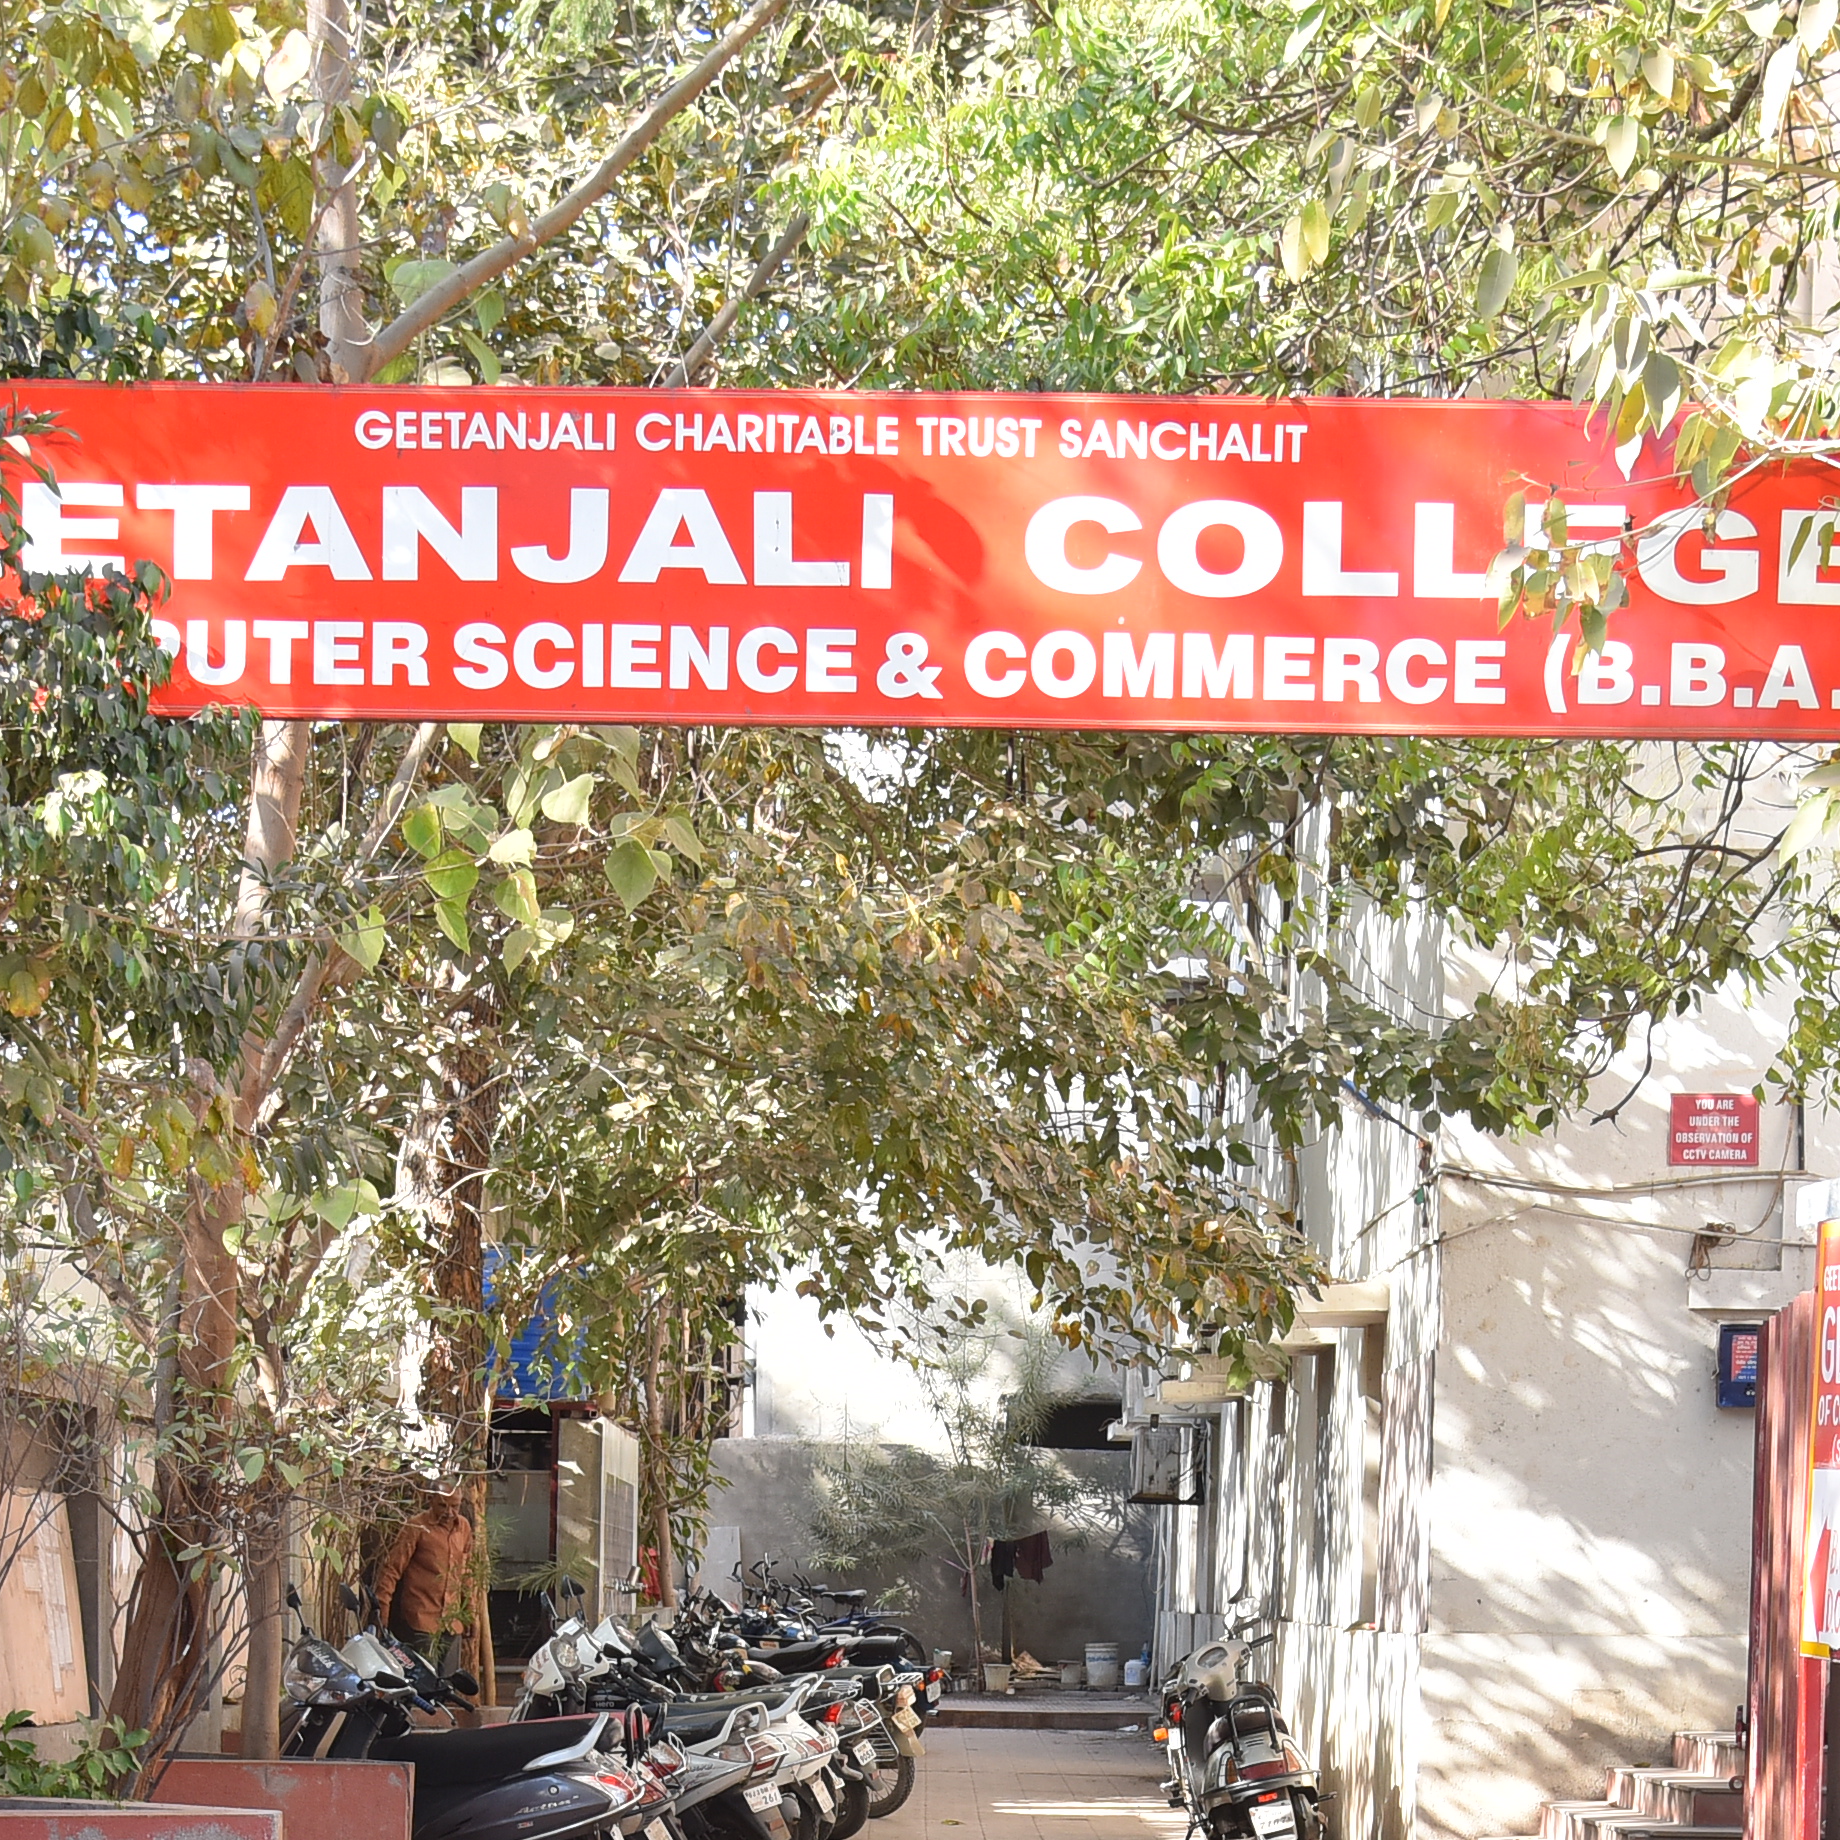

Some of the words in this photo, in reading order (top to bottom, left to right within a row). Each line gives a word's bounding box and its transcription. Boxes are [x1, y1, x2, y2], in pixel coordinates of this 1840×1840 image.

[354, 411, 615, 452] GEETANJALI
[635, 413, 899, 456] CHARITABLE
[917, 417, 1042, 458] TRUST
[1059, 420, 1308, 463] SANCHALIT
[452, 622, 857, 694] SCIENCE
[876, 632, 943, 699] &
[963, 629, 1506, 705] COMMERCE
[1695, 1099, 1715, 1110] YOU
[1716, 1099, 1735, 1110] ARE
[1688, 1115, 1720, 1127] UNDER
[1721, 1115, 1740, 1127] THE
[1675, 1132, 1739, 1144] OBSERVATION
[1741, 1132, 1754, 1144] OF
[1682, 1149, 1707, 1160] CCTV
[1708, 1149, 1748, 1160] CAMERA
[1817, 1395, 1833, 1427] OF
[762, 1791, 779, 1805] 261
